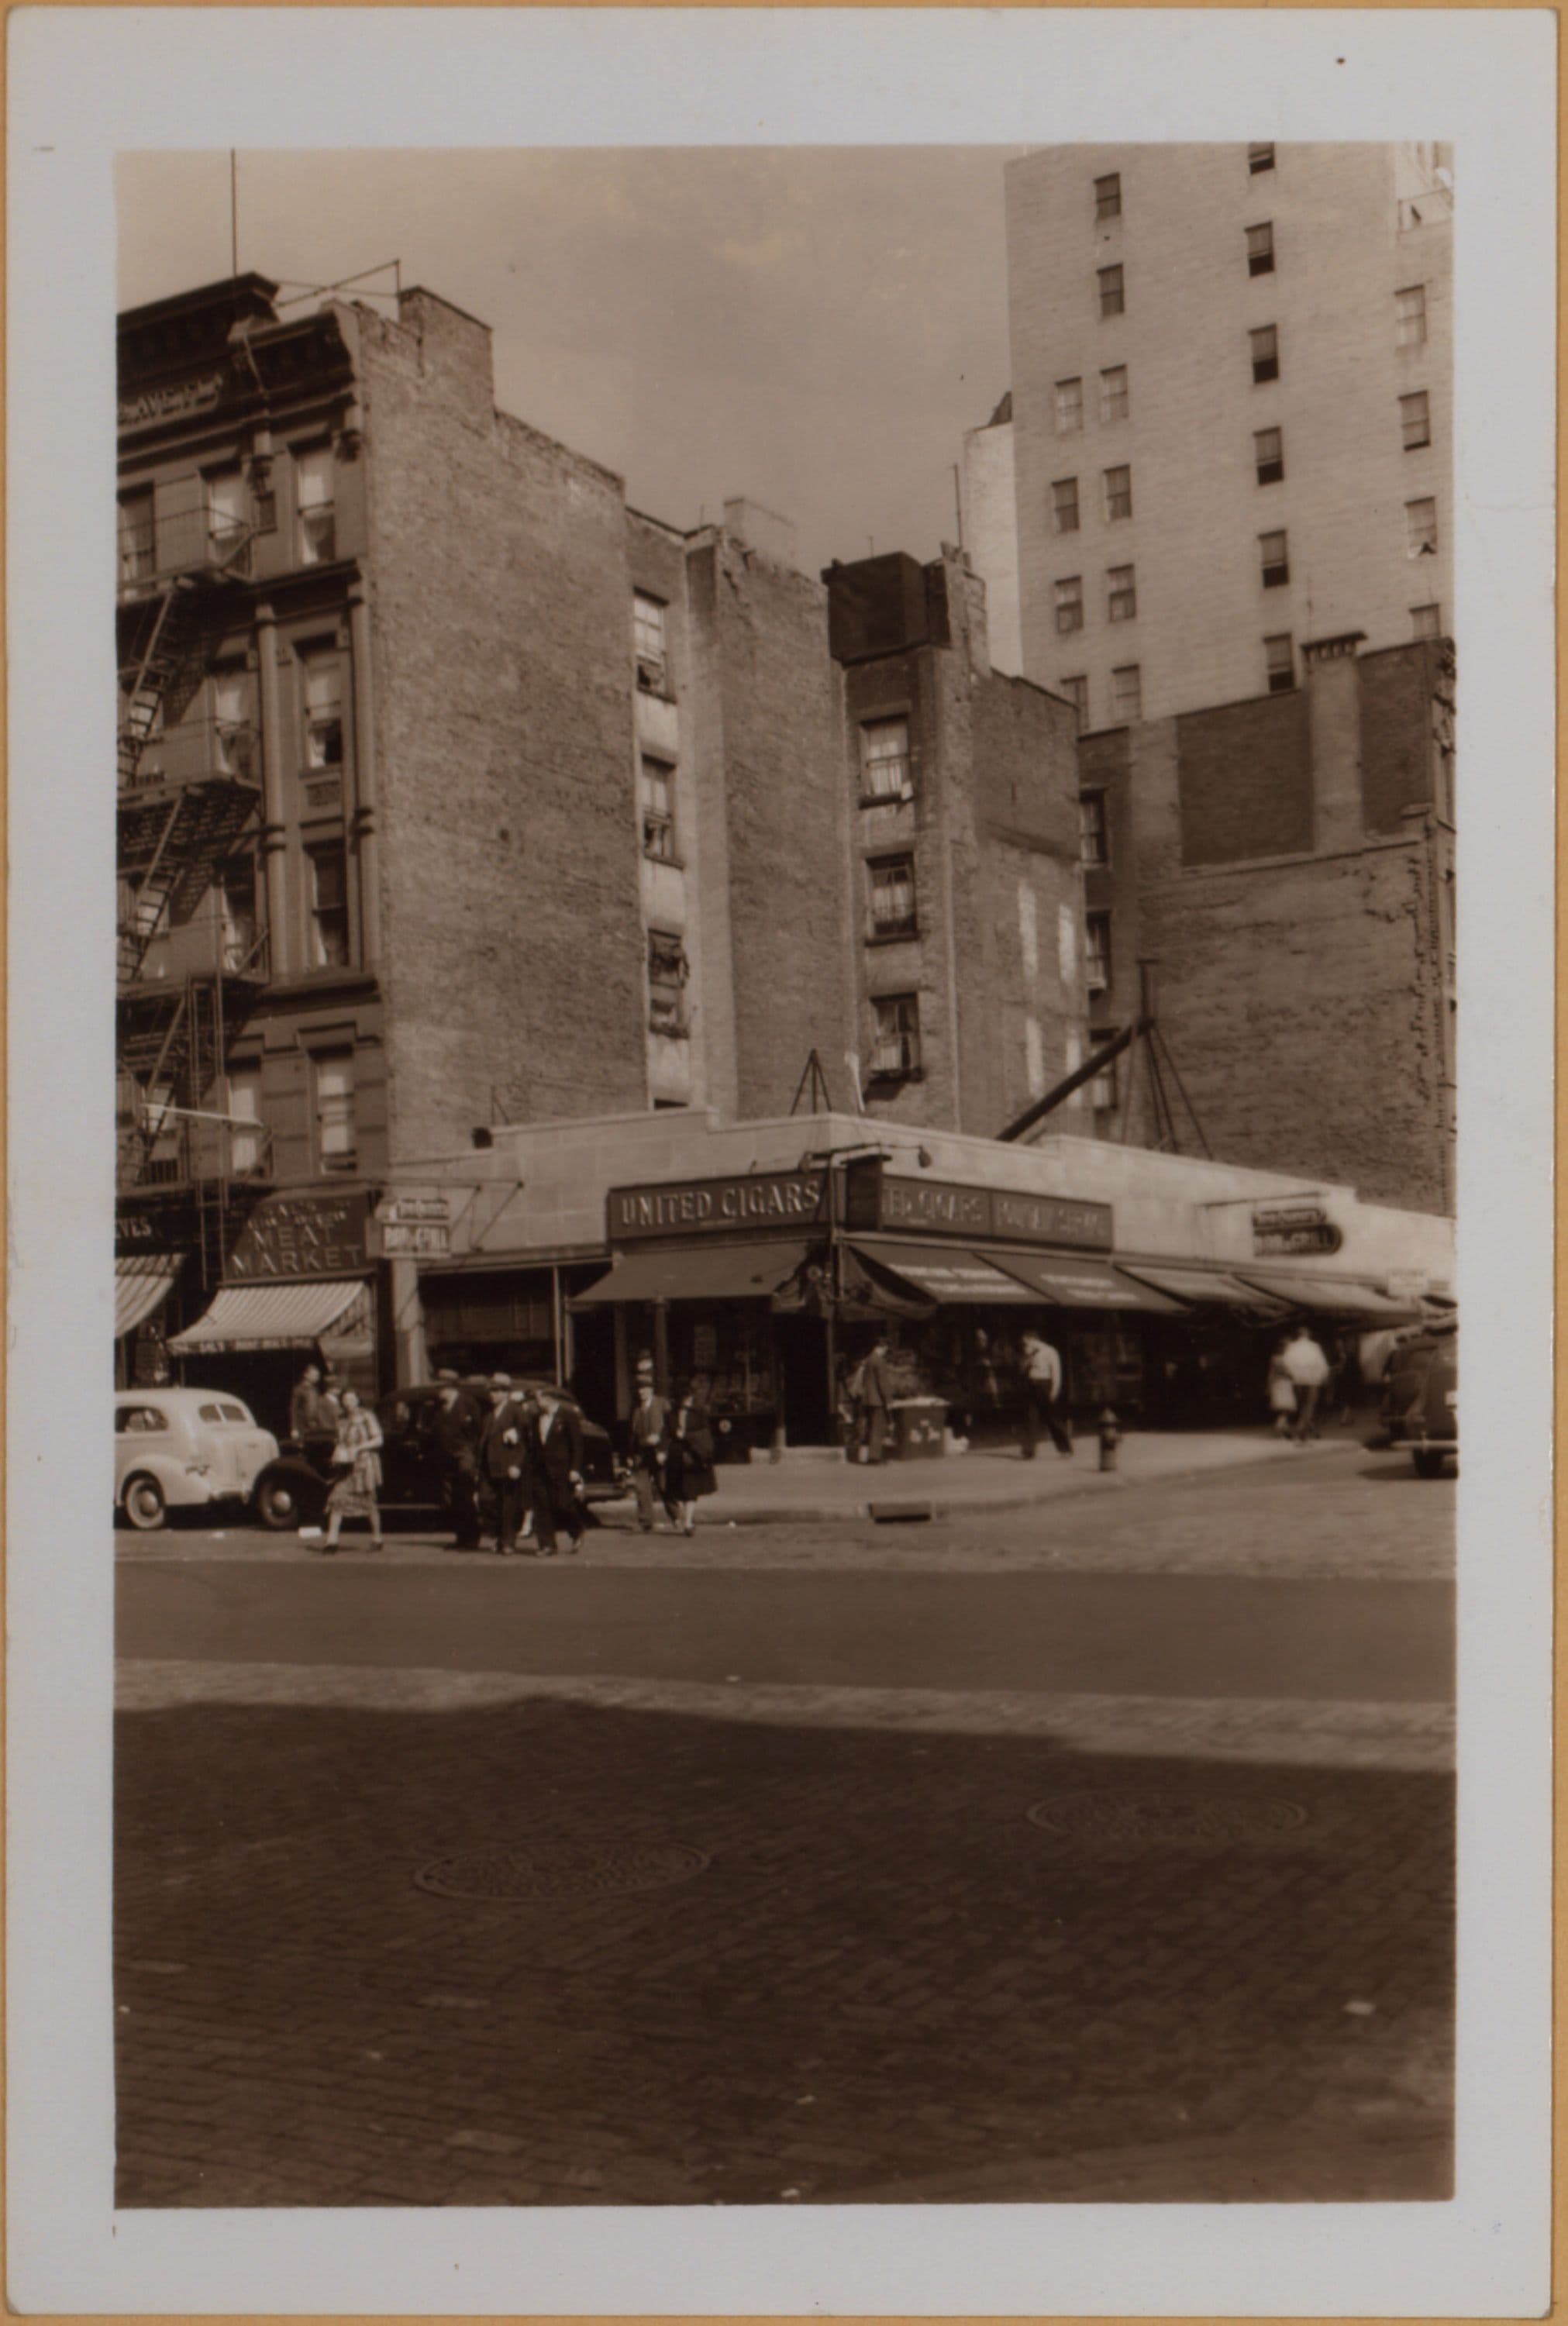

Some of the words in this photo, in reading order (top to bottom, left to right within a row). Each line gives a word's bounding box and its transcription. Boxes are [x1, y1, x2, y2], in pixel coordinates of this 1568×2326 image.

[621, 1190, 712, 1228] UNITED
[721, 1179, 821, 1218] CIGARS
[252, 1224, 333, 1252] MEAT
[231, 1244, 362, 1277] MARKET
